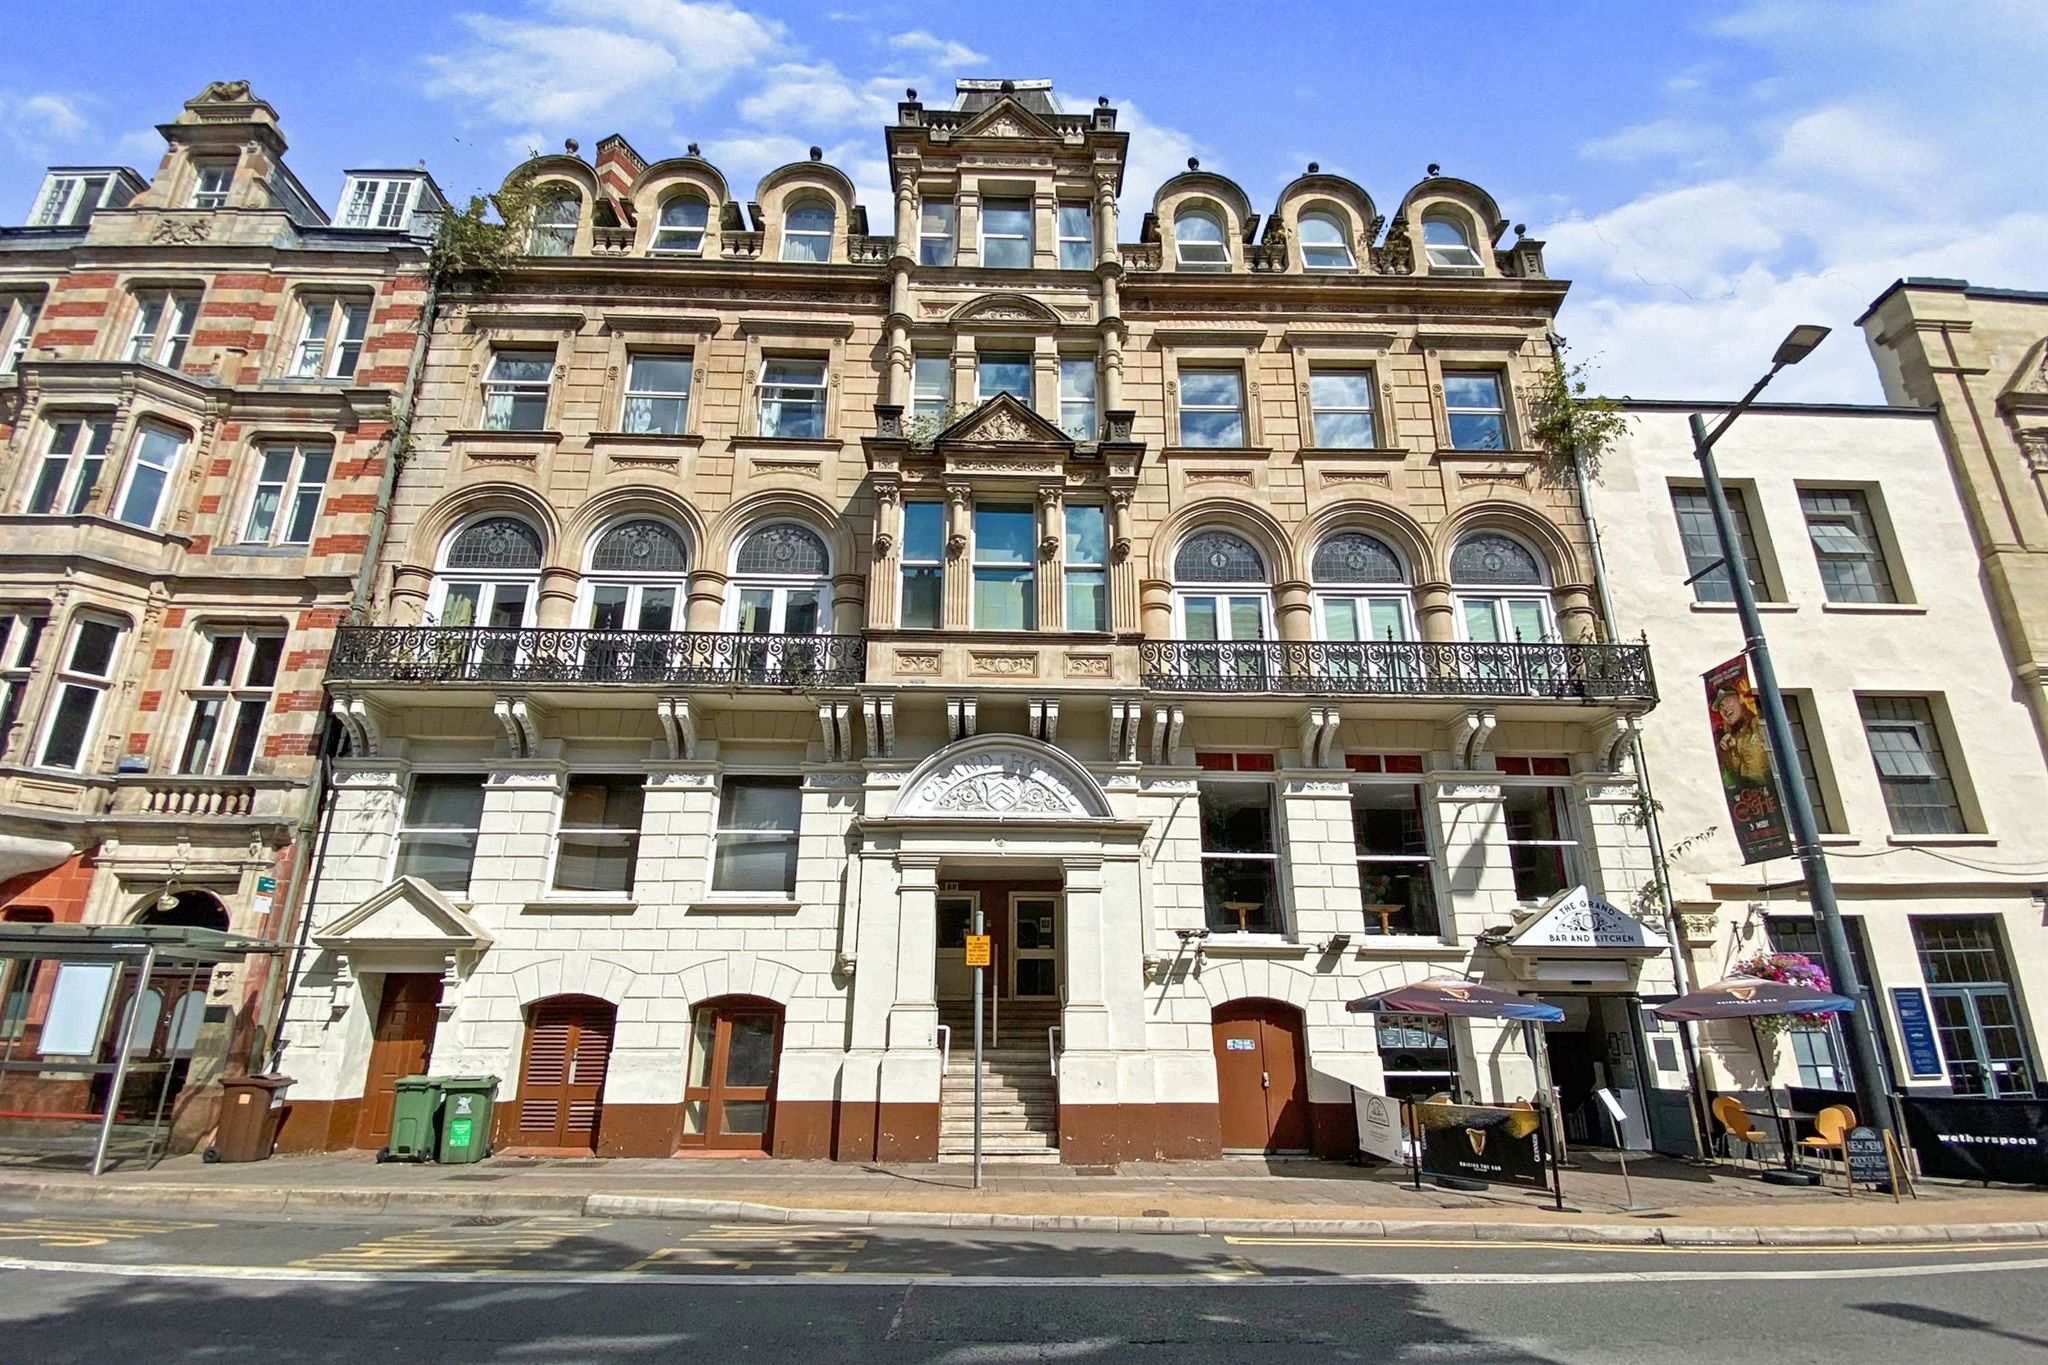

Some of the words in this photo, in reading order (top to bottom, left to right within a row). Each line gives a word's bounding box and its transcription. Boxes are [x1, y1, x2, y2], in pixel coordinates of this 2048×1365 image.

[922, 754, 993, 802] GRAND
[1011, 754, 1081, 807] HOTEL
[1559, 902, 1576, 915] THE
[1580, 900, 1616, 916] GRAND
[1549, 934, 1568, 942] BAR
[1571, 934, 1590, 942] AND
[1594, 934, 1635, 943] KITCHEN
[1937, 1133, 2038, 1146] wetherspoon
